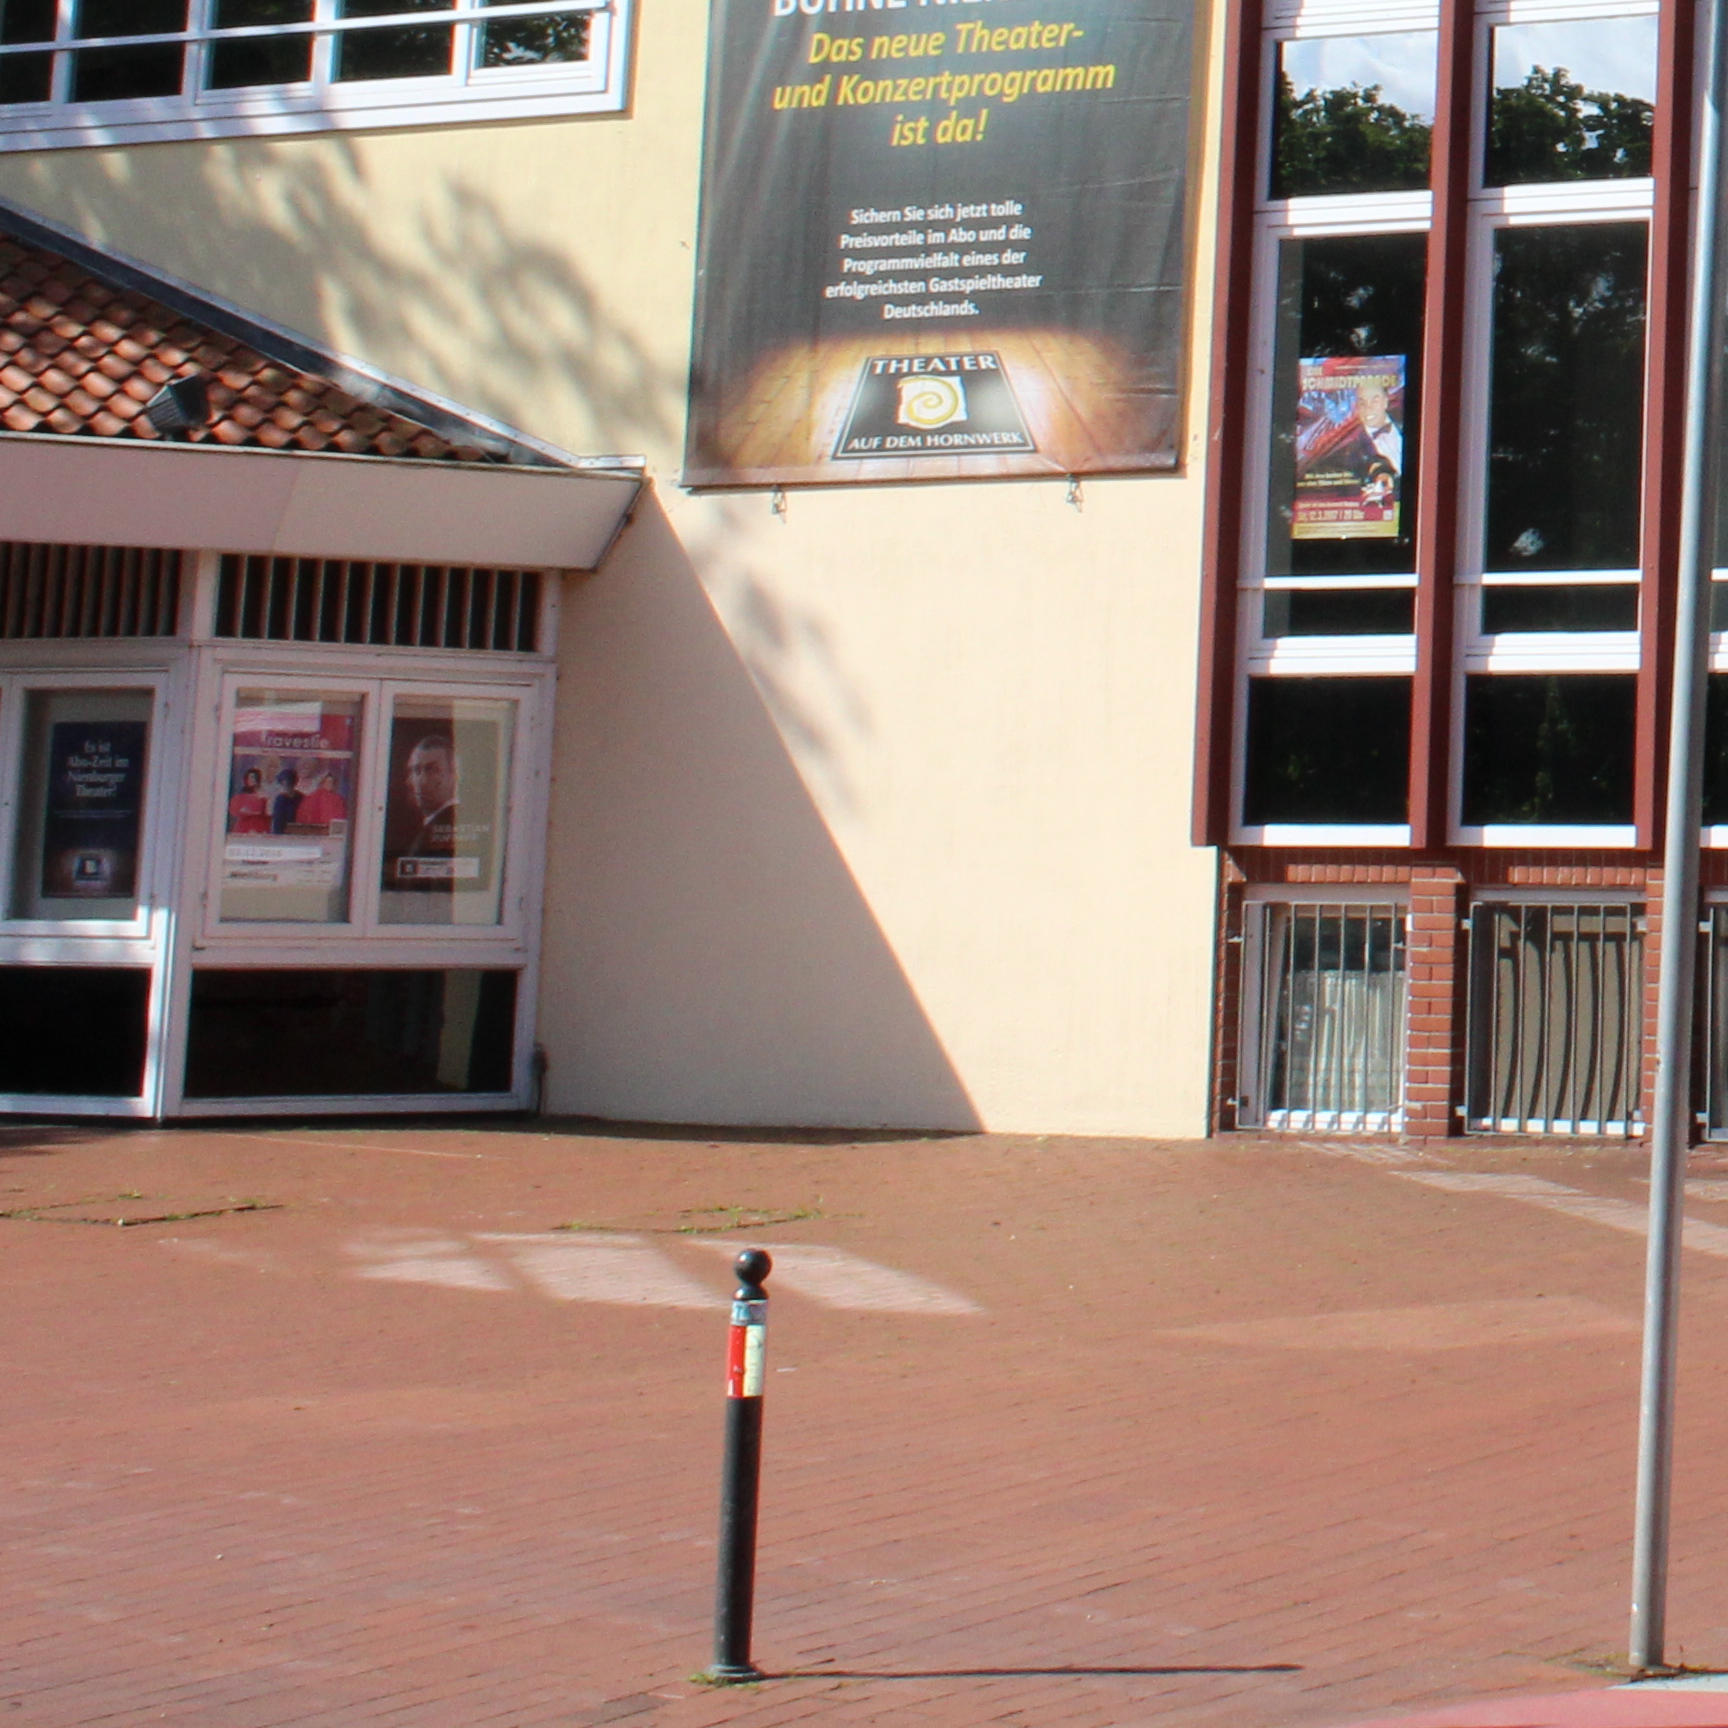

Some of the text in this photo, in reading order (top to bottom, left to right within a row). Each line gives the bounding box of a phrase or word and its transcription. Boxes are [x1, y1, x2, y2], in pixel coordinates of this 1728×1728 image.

[808, 19, 1086, 64] Das neue Theater-
[772, 62, 1117, 112] und Konzertprogramm
[890, 108, 991, 148] ist da!
[849, 199, 1024, 225] Sichern Sie sich jetzt tolle
[838, 223, 1032, 250] Preisvorteile im Abo und die
[841, 248, 1028, 275] Programmvielfalt eines der
[824, 273, 1043, 301] erfolgreichsten Gastspieltheater
[881, 299, 980, 320] Deutschlands.
[872, 354, 998, 376] THEATER
[849, 431, 1025, 450] AUF DEM HORNWERK
